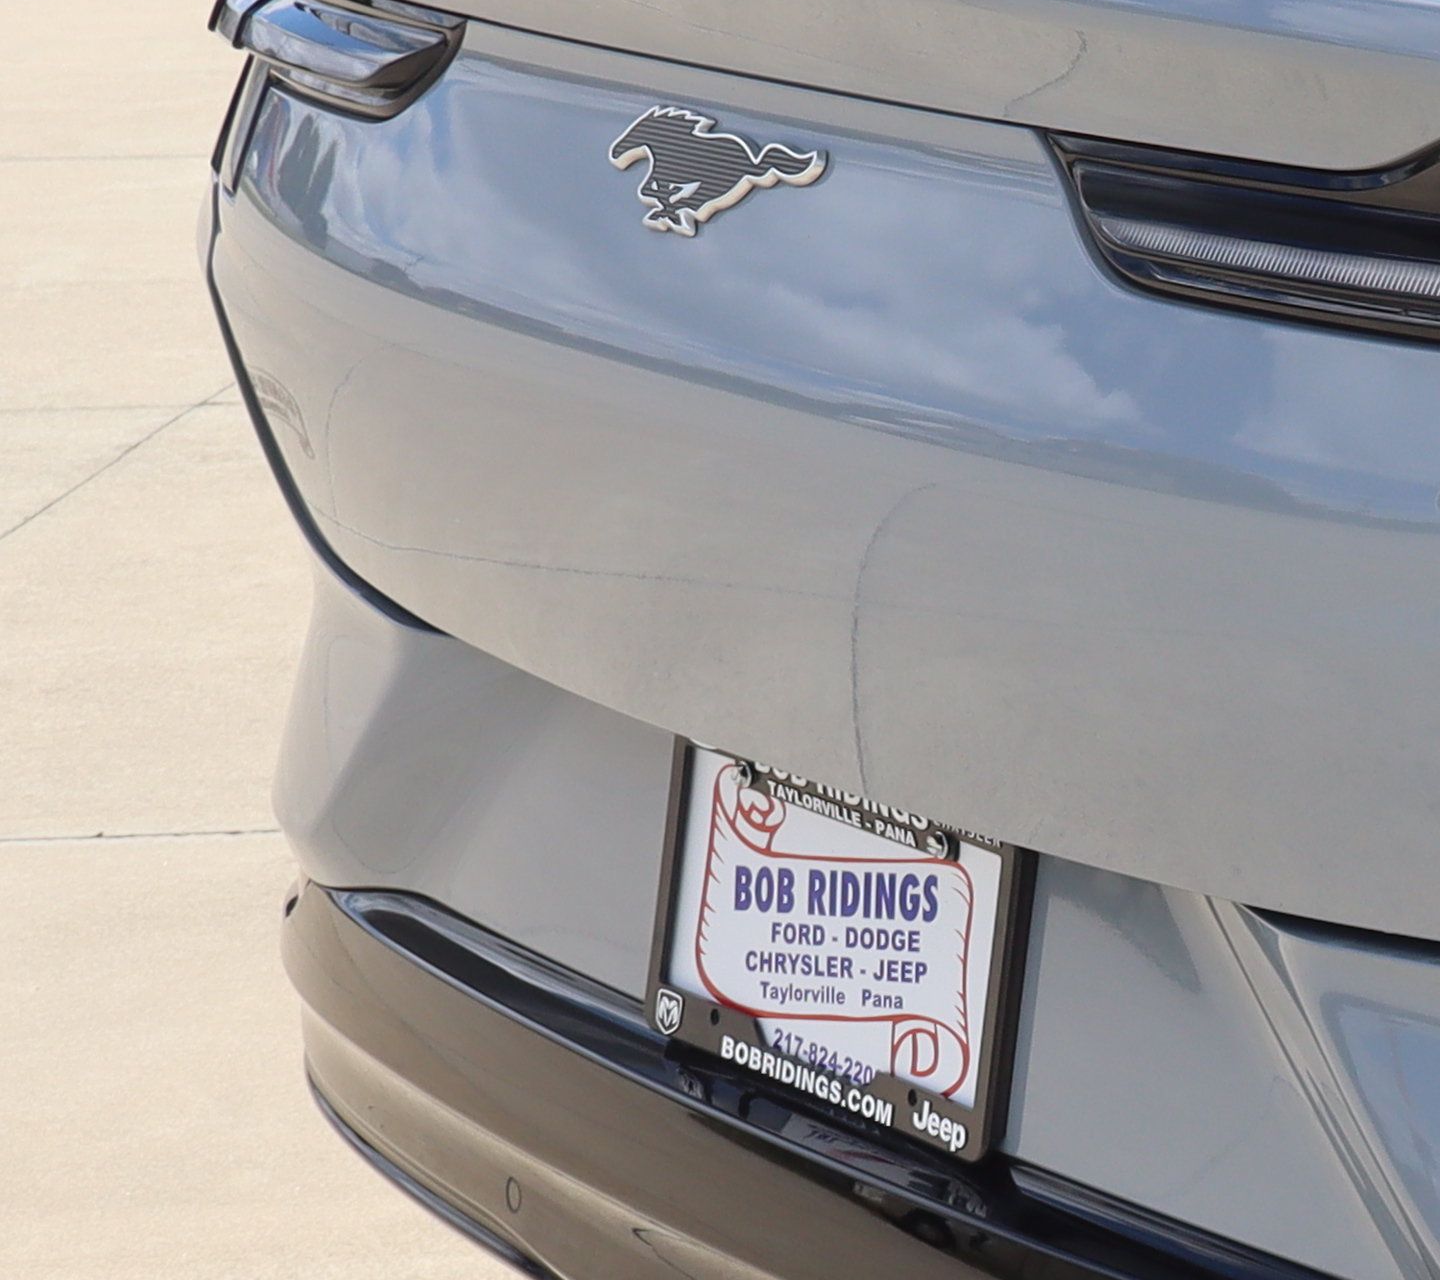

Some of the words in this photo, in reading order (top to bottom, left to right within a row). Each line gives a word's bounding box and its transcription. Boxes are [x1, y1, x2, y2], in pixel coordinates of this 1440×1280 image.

[767, 779, 862, 828] TAYLORVILLE
[875, 820, 917, 848] PANA
[734, 865, 795, 913] BOB
[807, 869, 939, 922] RIDINGS
[771, 922, 825, 946] FORD
[845, 927, 921, 953] DODGE
[745, 950, 854, 979] CHRYSLER
[873, 960, 928, 984] JEEP
[760, 981, 846, 1005] Taylorville
[861, 989, 903, 1009] Pana
[720, 1035, 894, 1127] BOBRIDINGS.COM
[773, 1028, 875, 1086] 217-824-220
[912, 1100, 966, 1151] Jeep
